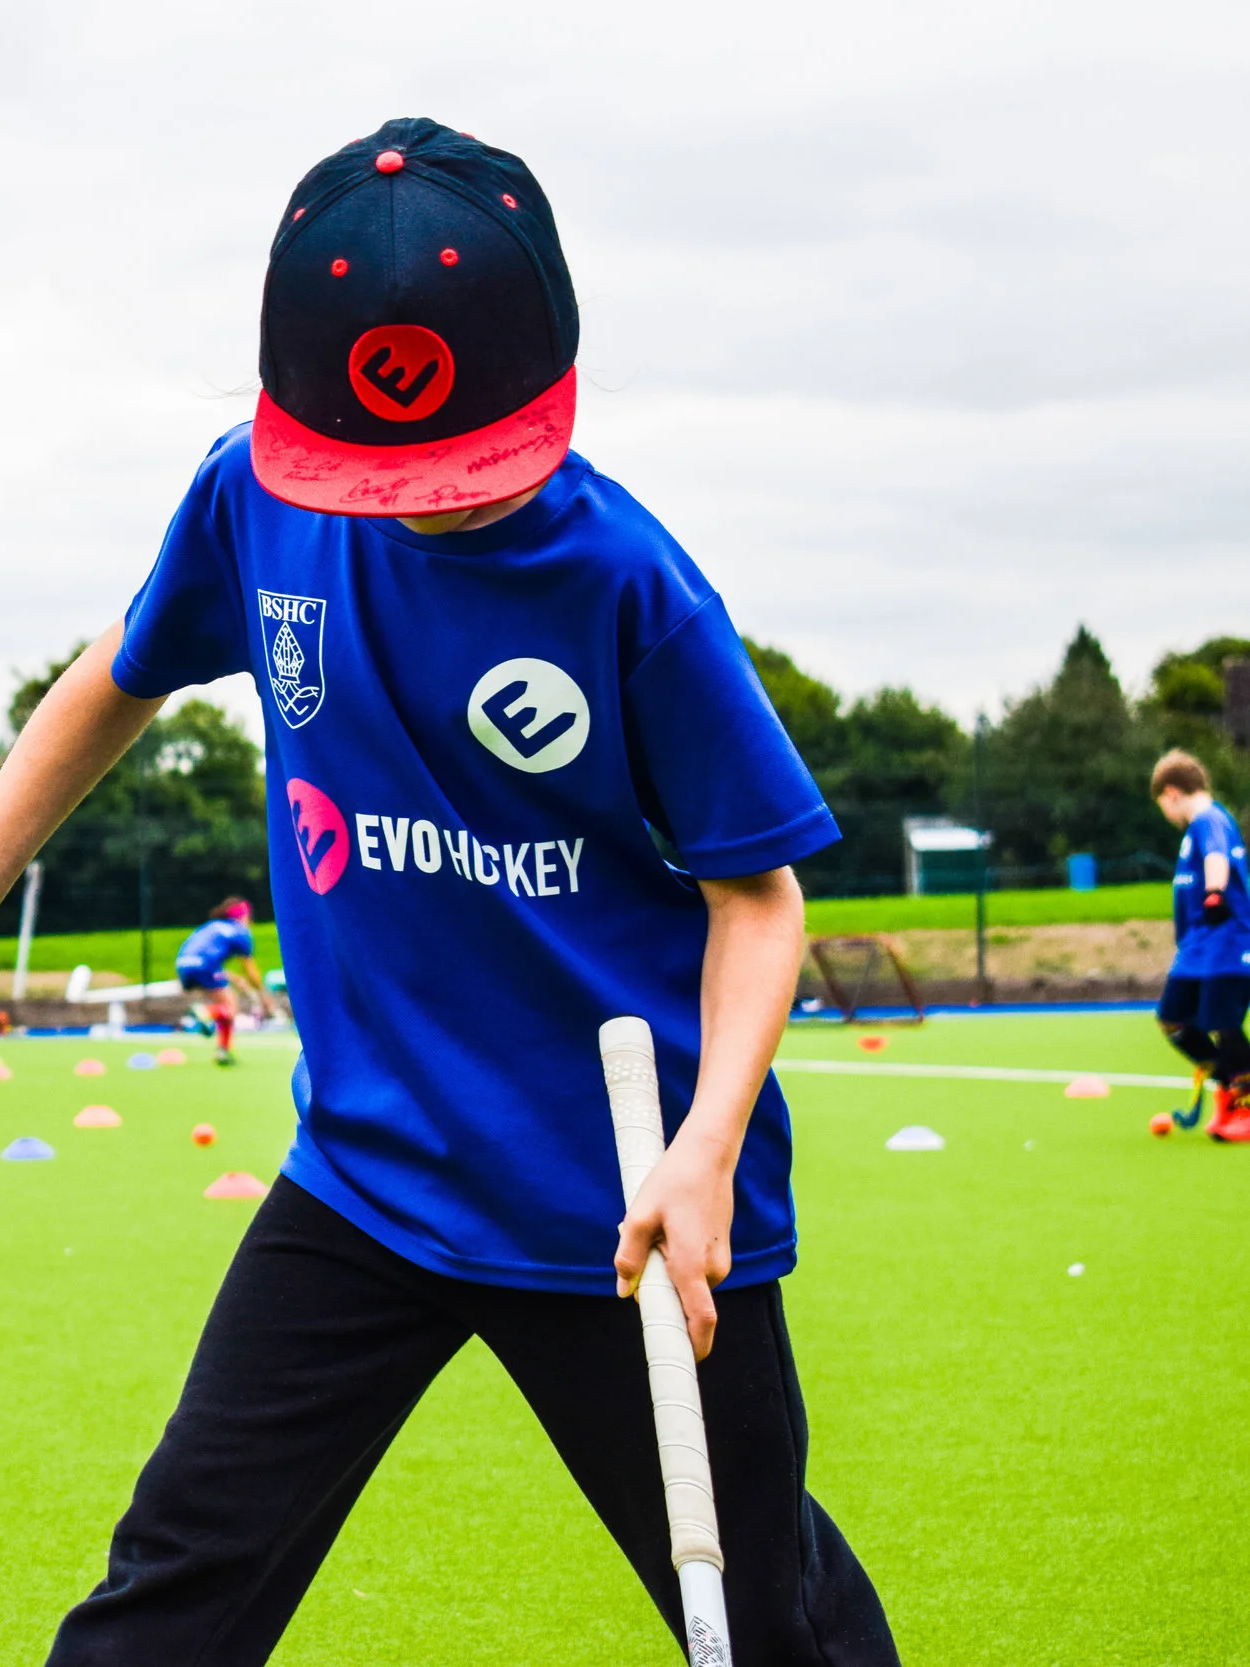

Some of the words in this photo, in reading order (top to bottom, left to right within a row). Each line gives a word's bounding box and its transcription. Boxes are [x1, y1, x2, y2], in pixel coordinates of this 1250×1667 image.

[359, 345, 440, 409] E
[261, 594, 317, 625] BSHC
[481, 680, 577, 759] E
